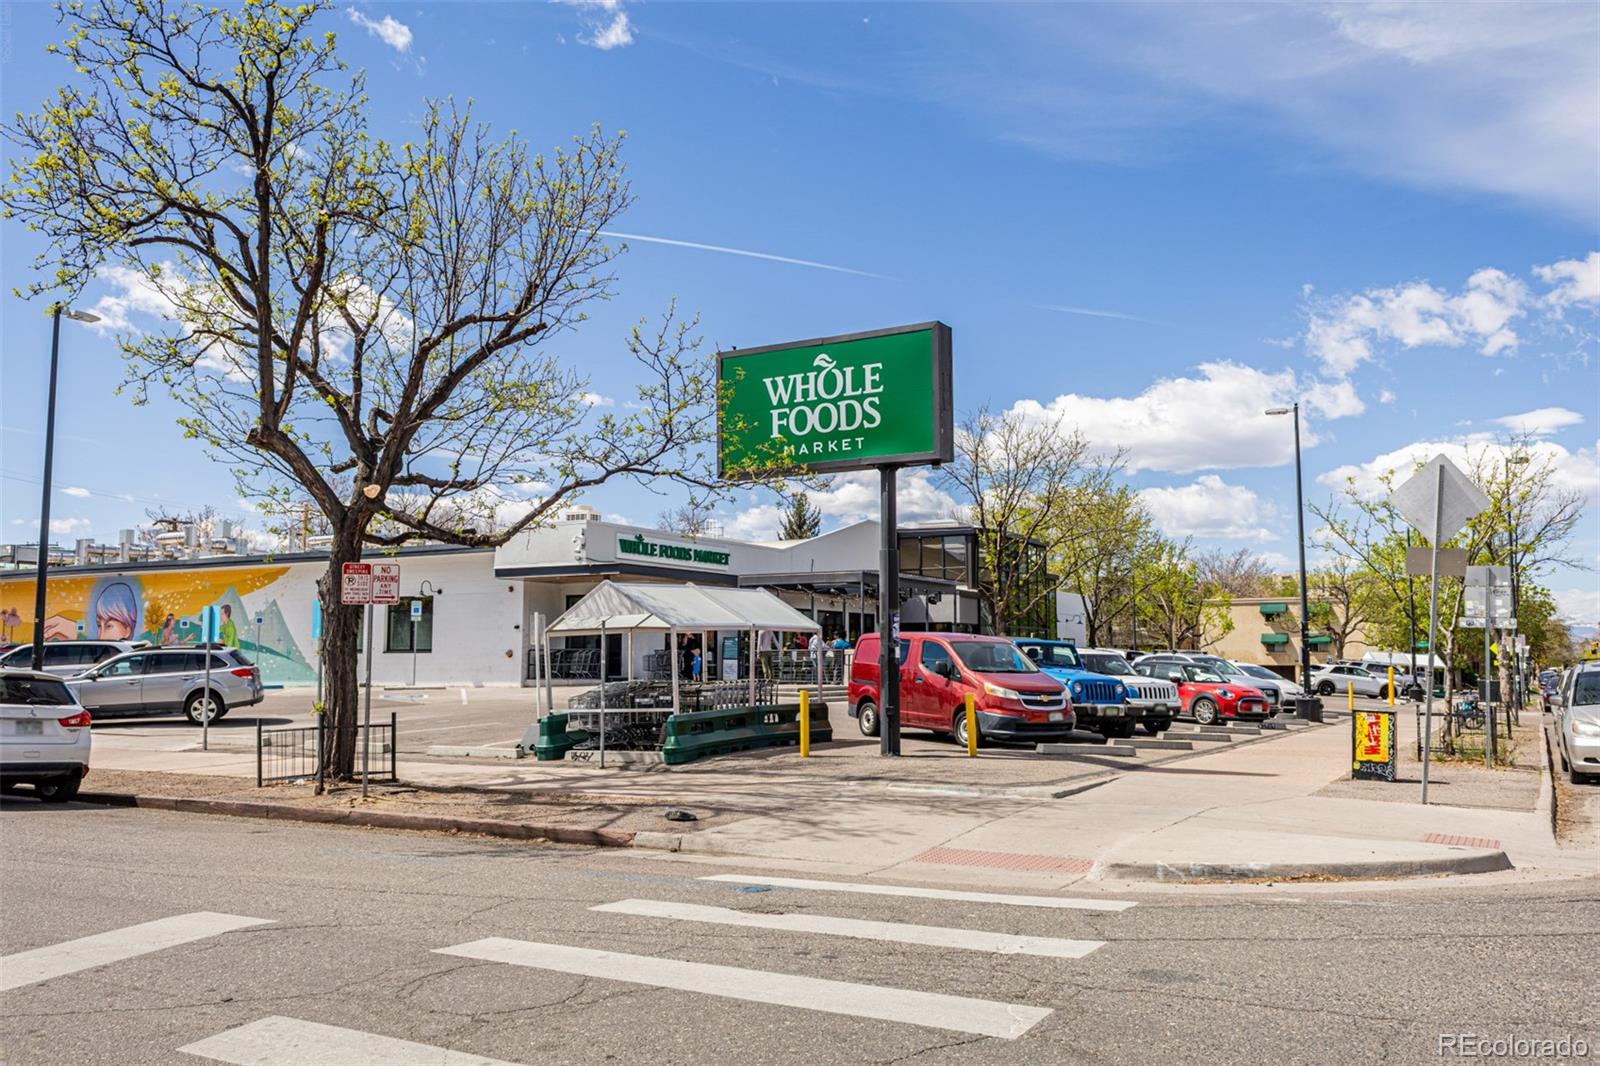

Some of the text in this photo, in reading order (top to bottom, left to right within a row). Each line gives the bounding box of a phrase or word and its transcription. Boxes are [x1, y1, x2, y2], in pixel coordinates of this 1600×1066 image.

[762, 353, 884, 406] WHOLE
[770, 396, 881, 438] FOODS
[618, 534, 731, 565] WHOLE FOODS MARKET
[381, 566, 392, 574] NO
